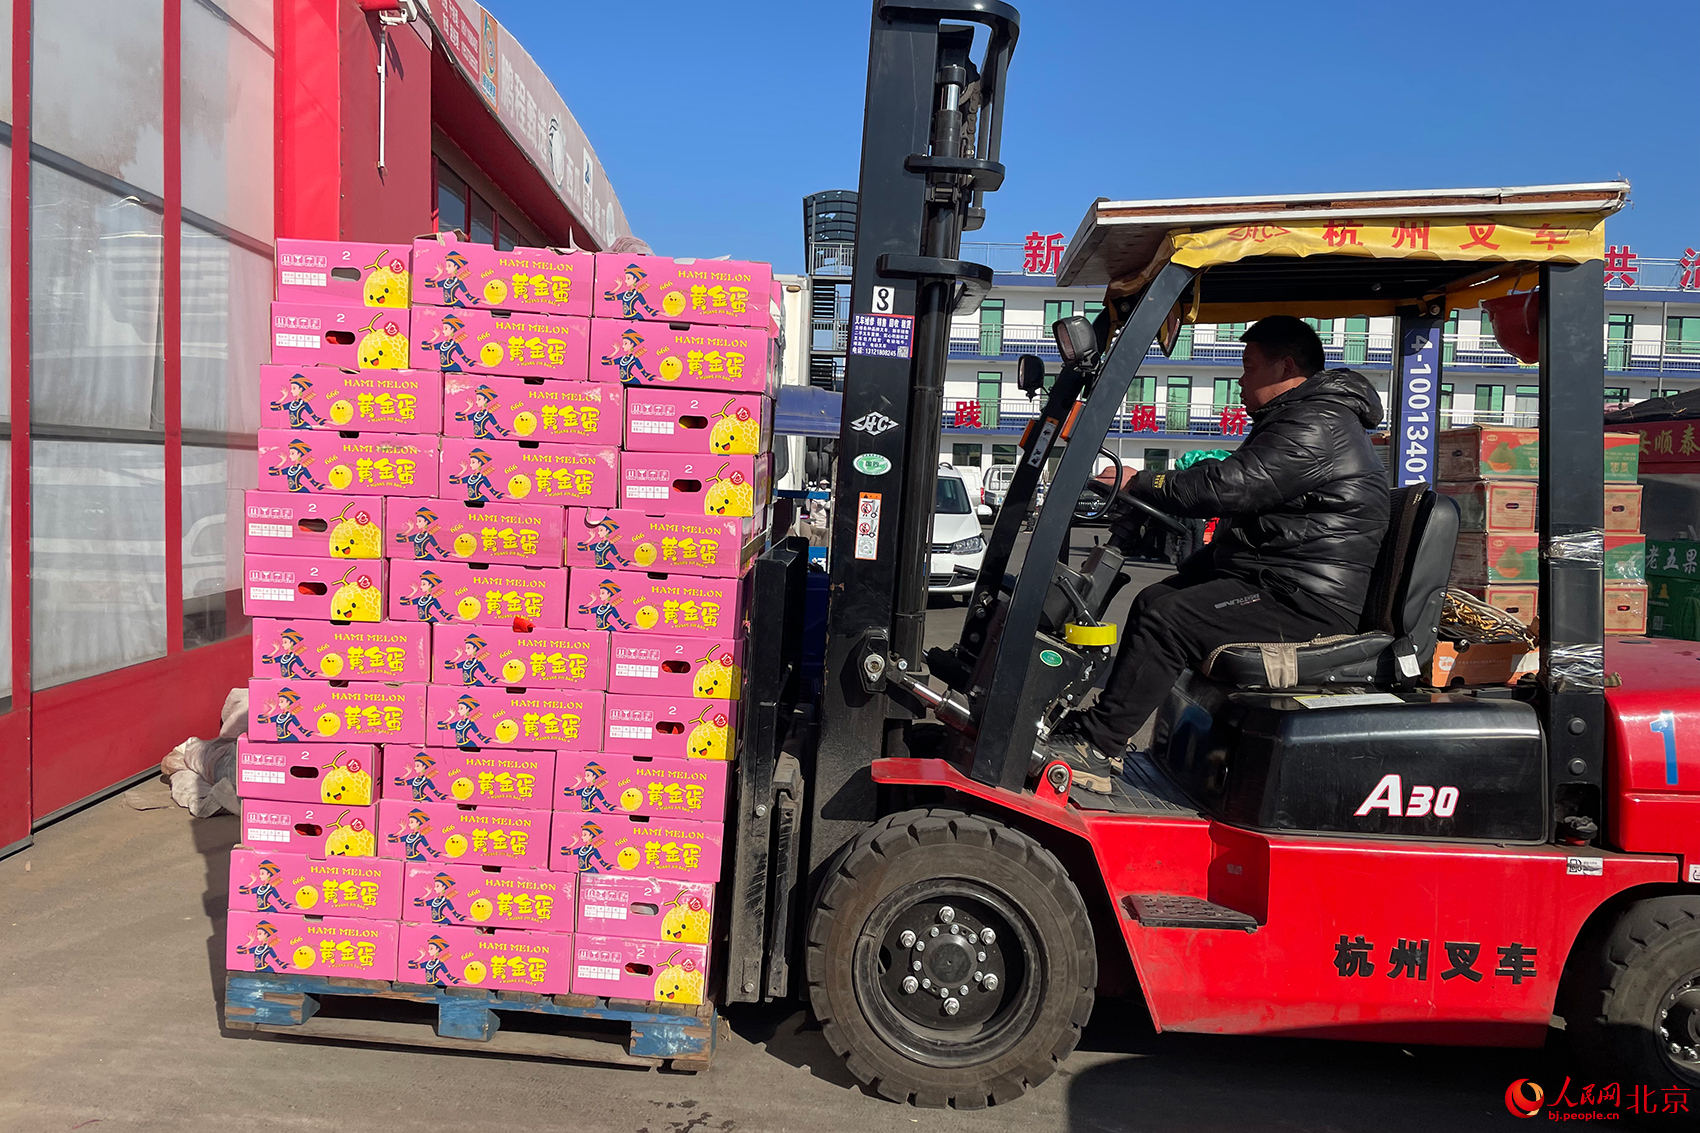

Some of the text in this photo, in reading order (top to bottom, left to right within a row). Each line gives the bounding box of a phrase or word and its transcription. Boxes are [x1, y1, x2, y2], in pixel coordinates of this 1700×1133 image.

[1322, 220, 1570, 250] 杭州叉车
[342, 250, 351, 261] 2
[1023, 231, 1065, 274] 新
[499, 259, 573, 271] HAMI MELON
[677, 271, 751, 282] HAMI MELON
[512, 273, 571, 303] 黄金蛋
[690, 284, 749, 314] 黄金蛋
[336, 313, 346, 323] 2
[495, 322, 569, 334] HAMI MELON
[674, 336, 747, 347] HAMI MELON
[508, 336, 567, 365] 黄金蛋
[687, 350, 745, 378] 黄金蛋
[343, 379, 418, 388] HAMI MELON
[528, 391, 558, 400] HAMI
[357, 392, 417, 422] 黄金蛋
[690, 399, 699, 409] 2
[541, 405, 600, 433] 黄金蛋
[953, 401, 982, 428] 践
[522, 454, 596, 465] HAMI MELON
[356, 458, 416, 487] 黄金蛋
[684, 464, 693, 474] 2
[535, 468, 594, 496] 黄金蛋
[308, 503, 317, 513] 2
[468, 514, 541, 524] HAMI MELON
[649, 523, 721, 535] HAMI MELON
[481, 527, 539, 555] 黄金蛋
[661, 537, 719, 565] 黄金蛋
[309, 567, 319, 577] 2
[472, 577, 546, 588] HAMI MELON
[651, 586, 722, 597] HAMI MELON
[485, 590, 544, 618] 黄金蛋
[663, 600, 720, 627] 黄金蛋
[367, 634, 407, 642] MELON
[517, 639, 590, 649] HAMI MELON
[675, 644, 684, 654] 2
[347, 646, 406, 675] 黄金蛋
[530, 652, 588, 681] 黄金蛋
[543, 701, 583, 709] MELON
[668, 705, 677, 715] 2
[344, 705, 403, 734] 黄金蛋
[523, 712, 581, 741] 黄金蛋
[1649, 709, 1679, 785] 1
[300, 750, 310, 760] 2
[498, 760, 537, 769] MELON
[636, 769, 707, 780] HAMI MELON
[478, 771, 535, 798] 黄金蛋
[647, 782, 704, 809] 黄金蛋
[1353, 774, 1460, 817] A30
[305, 810, 314, 820] 2
[460, 815, 531, 826] HAMI MELON
[633, 828, 704, 839] HAMI MELON
[472, 828, 529, 856] 黄金蛋
[644, 841, 702, 868] 黄金蛋
[310, 866, 381, 877] HAMI MELON
[485, 879, 556, 890] HAMI MELON
[322, 879, 379, 907] 黄金蛋
[643, 887, 653, 897] 2
[497, 892, 553, 920] 黄金蛋
[307, 926, 378, 937] HAMI MELON
[320, 940, 376, 967] 黄金蛋
[478, 942, 549, 953] HAMI MELON
[636, 948, 646, 958] 2
[1333, 935, 1537, 985] 杭州叉车
[490, 955, 547, 982] 黄金蛋
